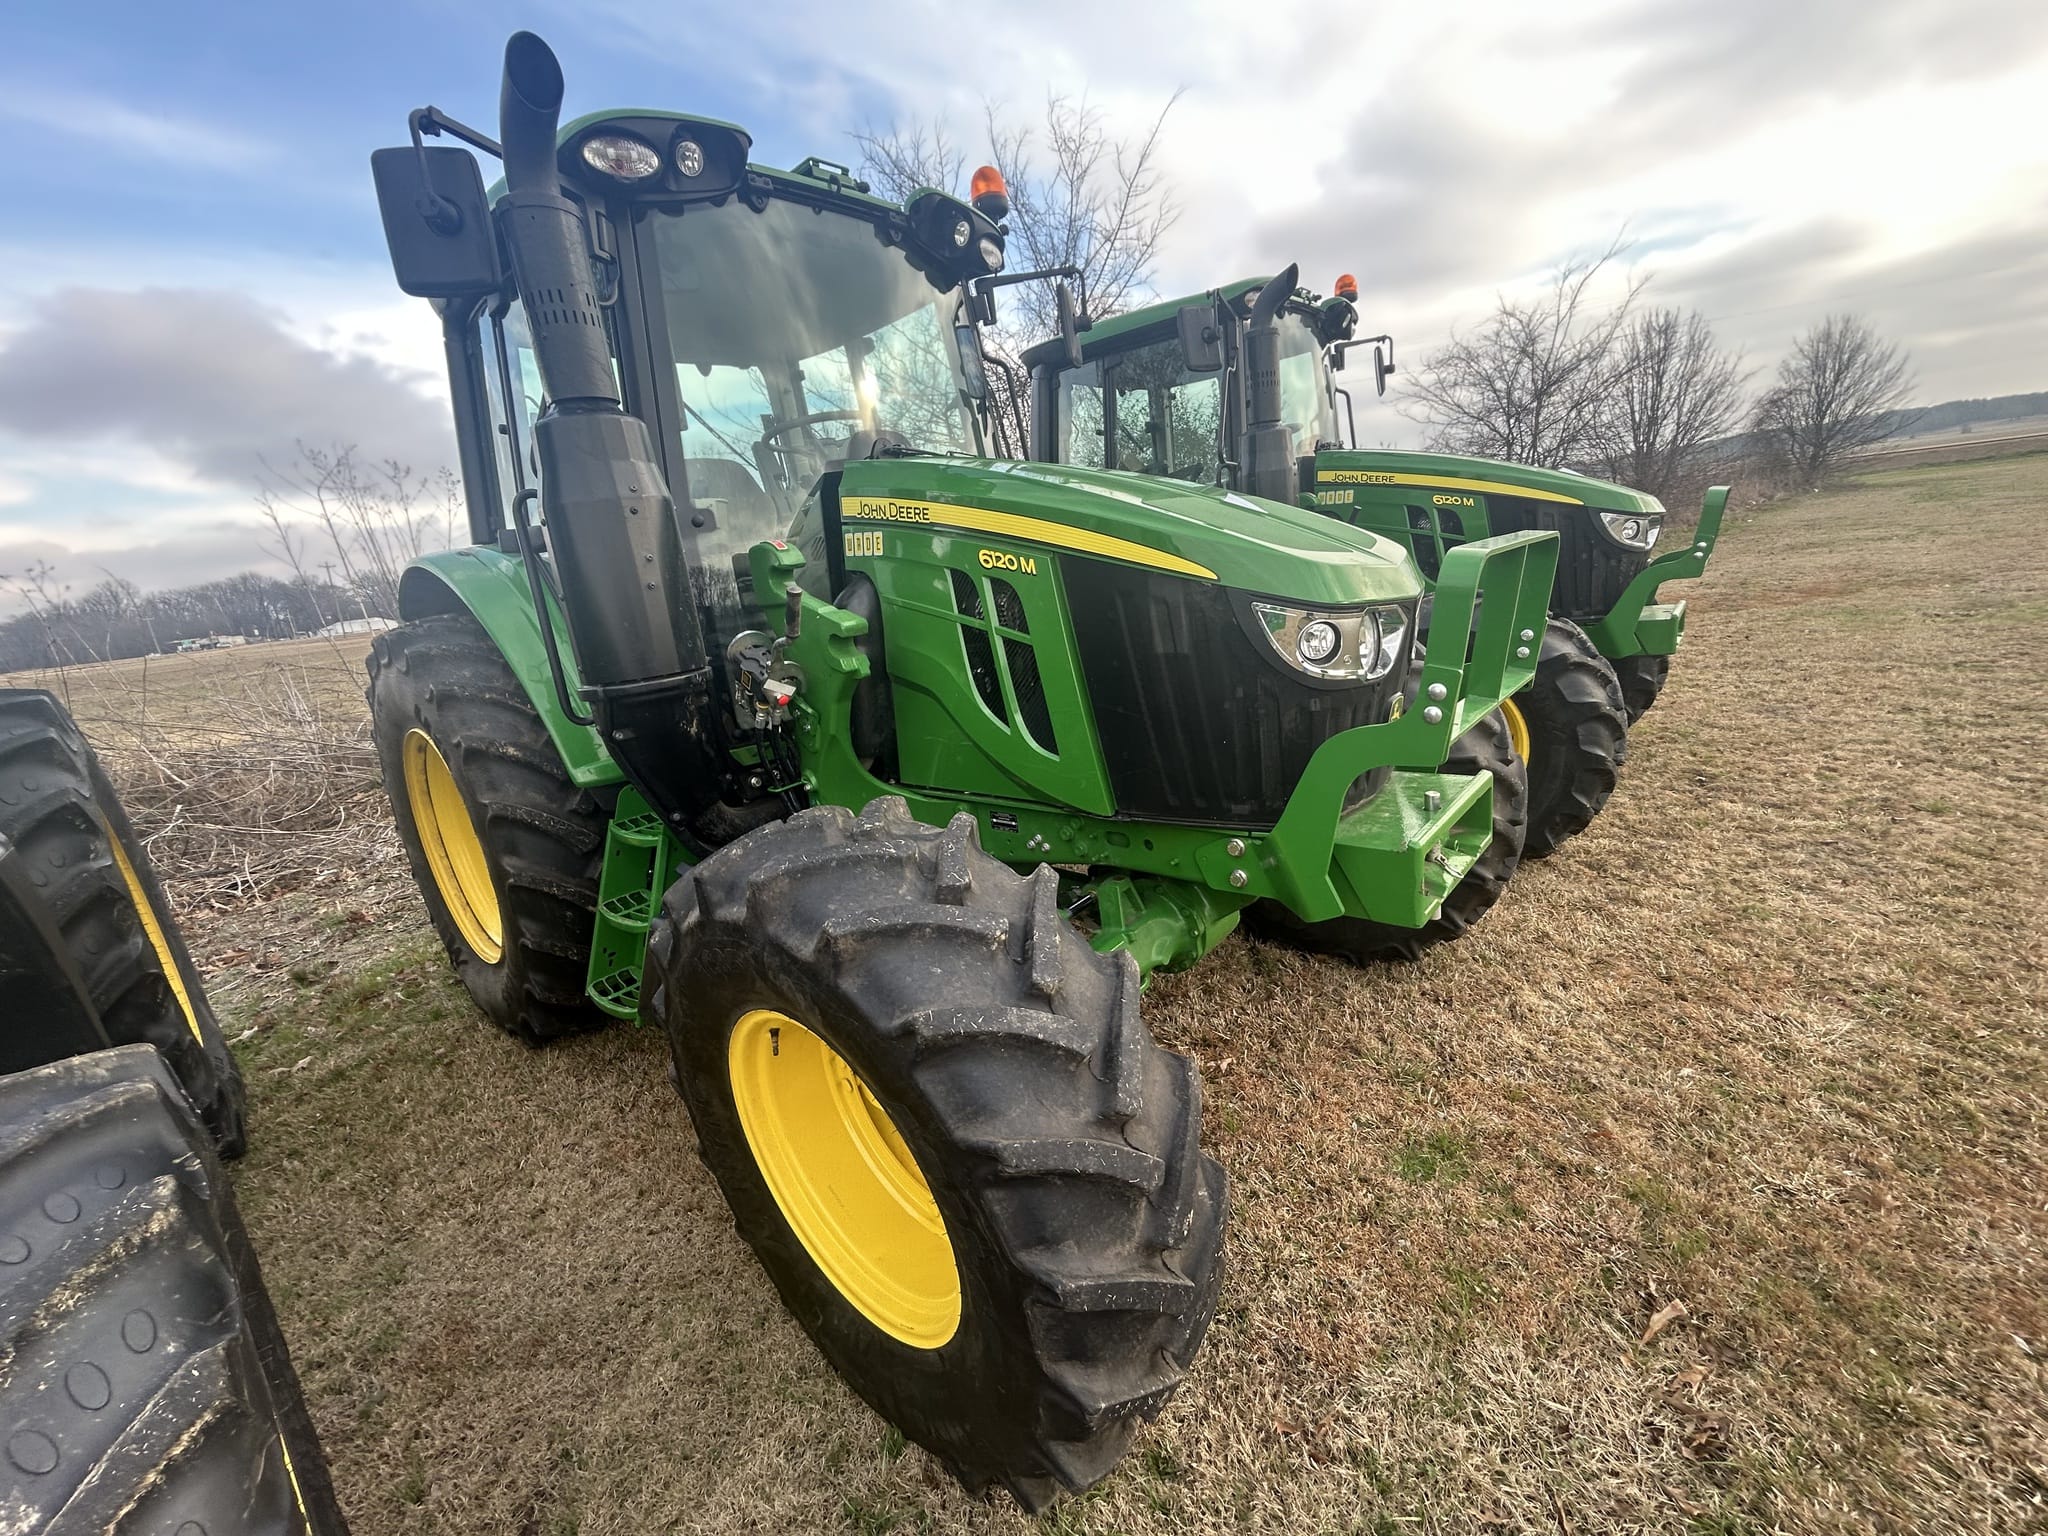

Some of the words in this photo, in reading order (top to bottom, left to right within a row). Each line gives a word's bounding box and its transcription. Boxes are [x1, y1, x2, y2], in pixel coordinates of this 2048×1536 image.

[1331, 472, 1358, 482] JOHN
[1360, 473, 1395, 483] DEERE
[1432, 494, 1461, 505] 6120
[1463, 497, 1474, 507] M
[857, 501, 887, 518] JOHN
[888, 502, 930, 521] DEERE
[978, 549, 1018, 571] 6120
[1019, 556, 1037, 576] M
